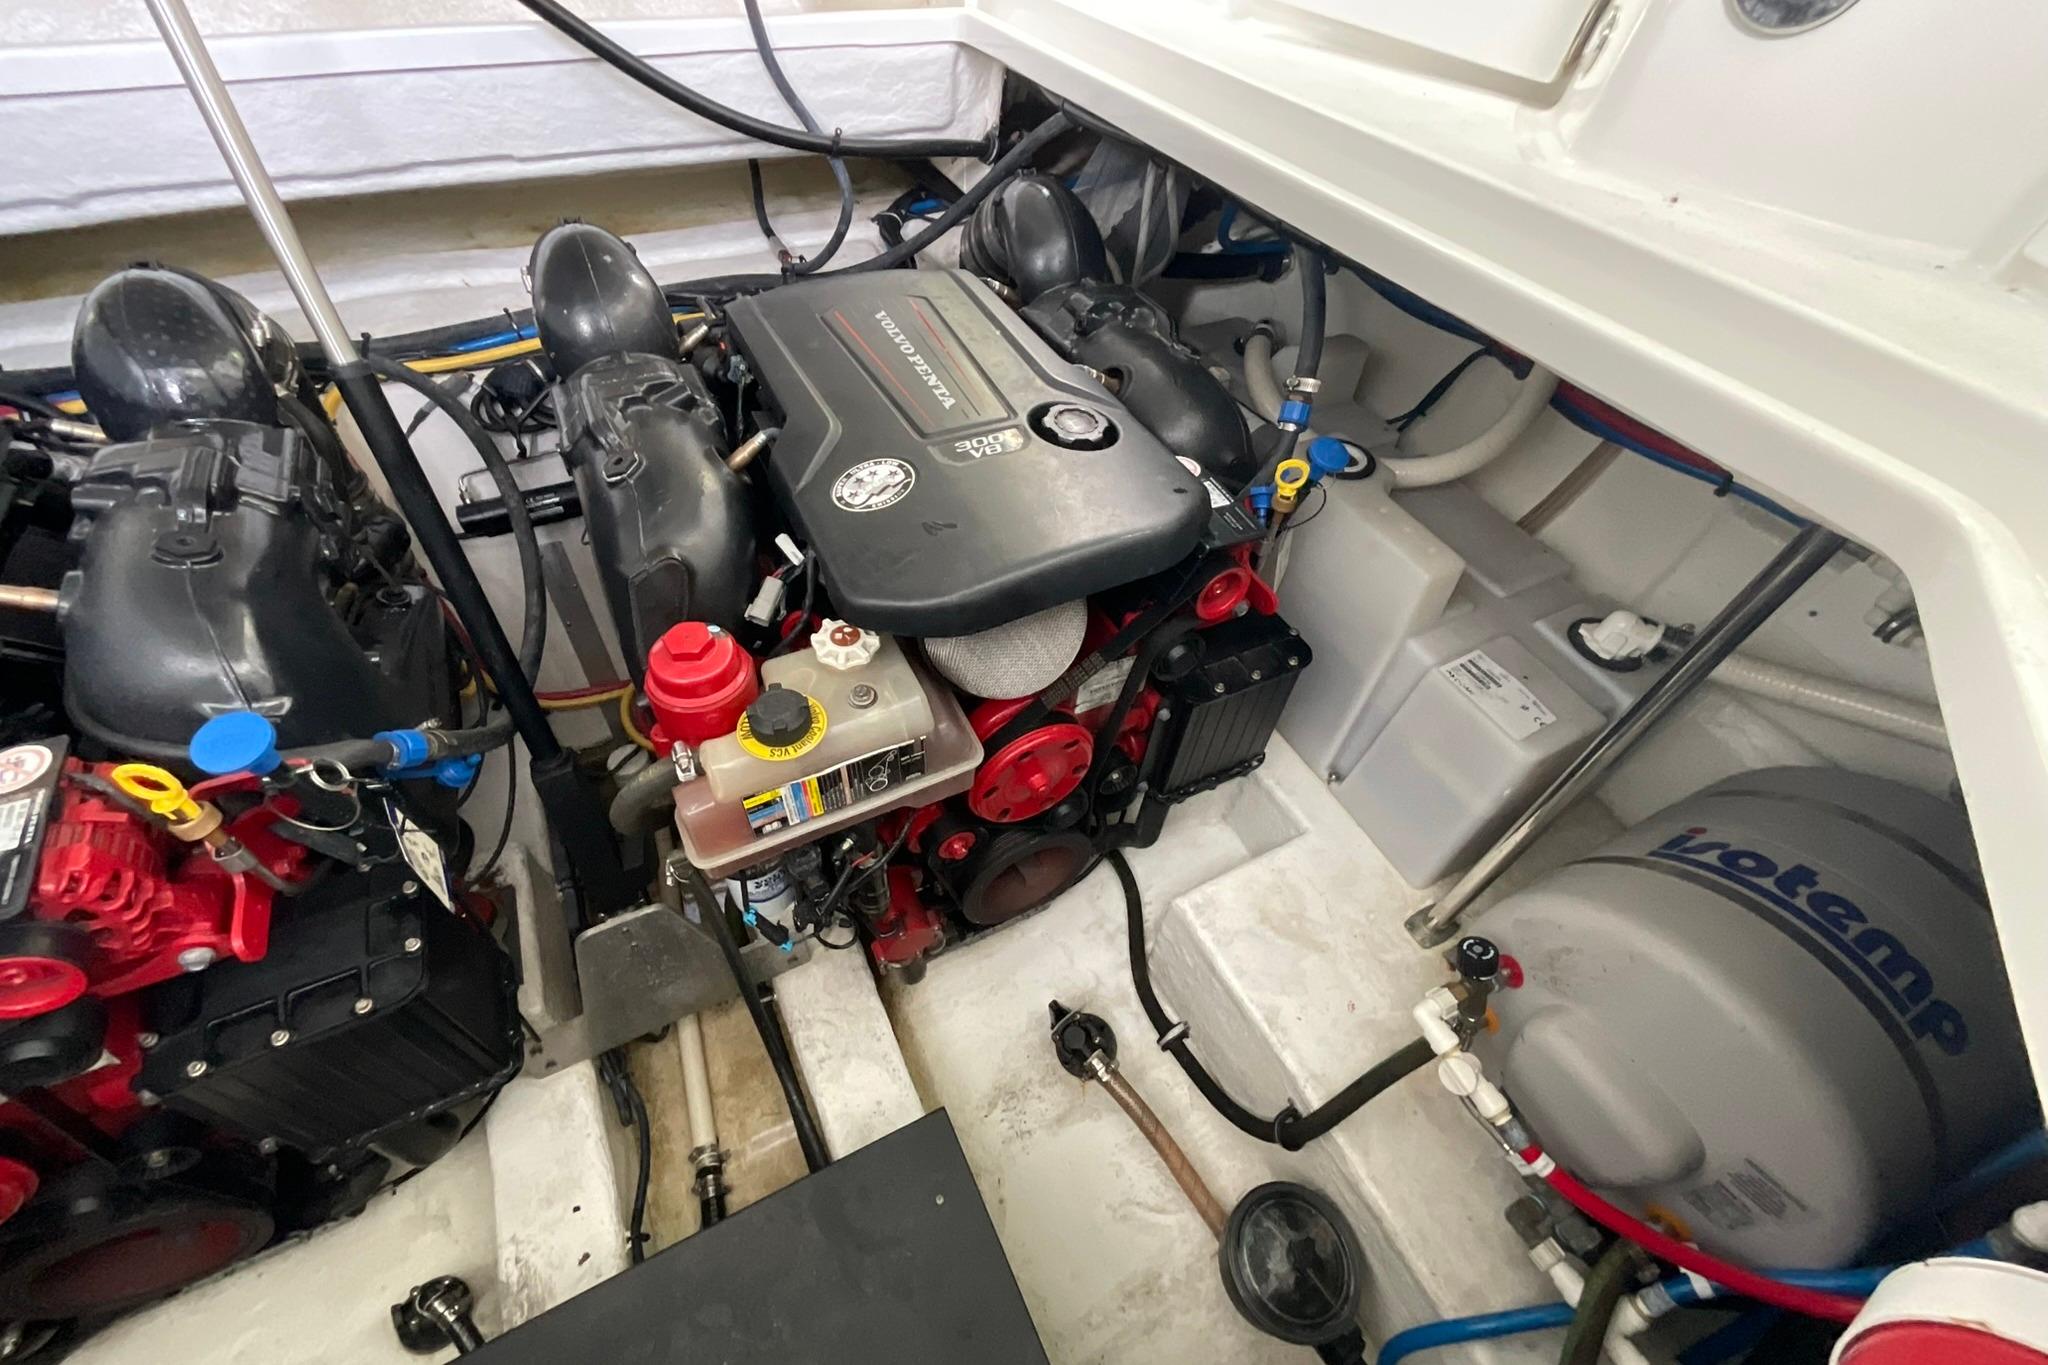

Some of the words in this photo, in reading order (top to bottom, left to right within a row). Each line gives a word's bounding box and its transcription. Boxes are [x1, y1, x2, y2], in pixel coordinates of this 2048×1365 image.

[874, 310, 915, 355] VOLVO
[906, 354, 956, 410] PENTA
[954, 433, 1004, 453] 300
[969, 443, 1002, 458] V8
[791, 725, 822, 753] Coolant
[769, 747, 791, 758] VCS
[1656, 826, 1968, 1056] isotemp
